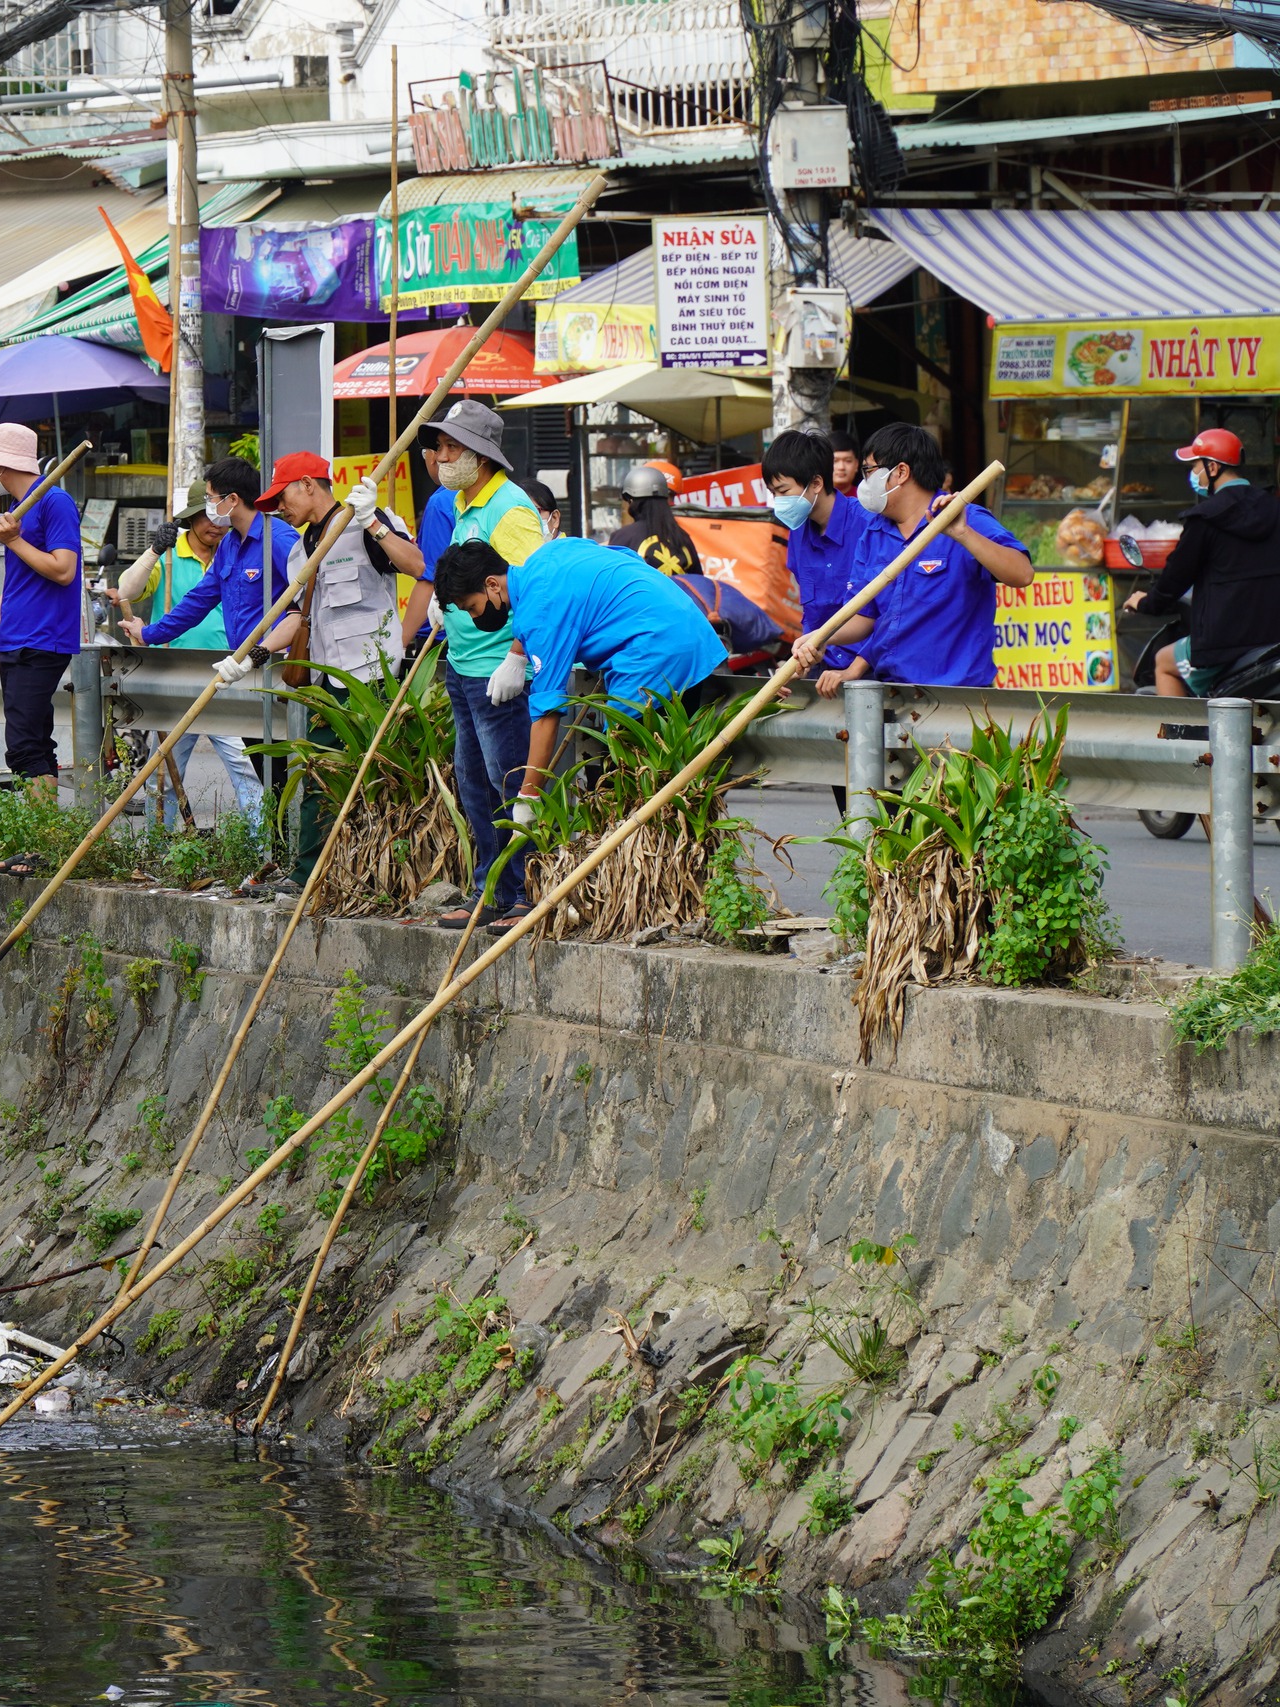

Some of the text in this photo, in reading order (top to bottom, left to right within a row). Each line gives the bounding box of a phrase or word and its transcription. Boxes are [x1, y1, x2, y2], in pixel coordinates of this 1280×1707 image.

[663, 224, 756, 250] NHẬN SỬA
[661, 251, 681, 263] BẾP
[686, 251, 710, 263] ĐIỆN
[721, 249, 741, 261] BẾP
[666, 264, 755, 277] BẾP HỒNG NGOẠI
[674, 279, 748, 290] NỒI CƠM ĐIỆN
[677, 292, 746, 303] MÁY SINH TỐ
[699, 307, 723, 317] SIÊU
[727, 306, 746, 316] TỐC
[671, 321, 697, 331] BÌNH
[729, 320, 754, 331] ĐIỆN
[670, 335, 691, 346] CÁC
[694, 335, 718, 347] LOẠI
[1148, 326, 1262, 388] NHẬT VY
[1033, 572, 1074, 607] RIÊU
[994, 616, 1071, 653] BÚN MỌC
[995, 655, 1085, 689] CANH BÚN
